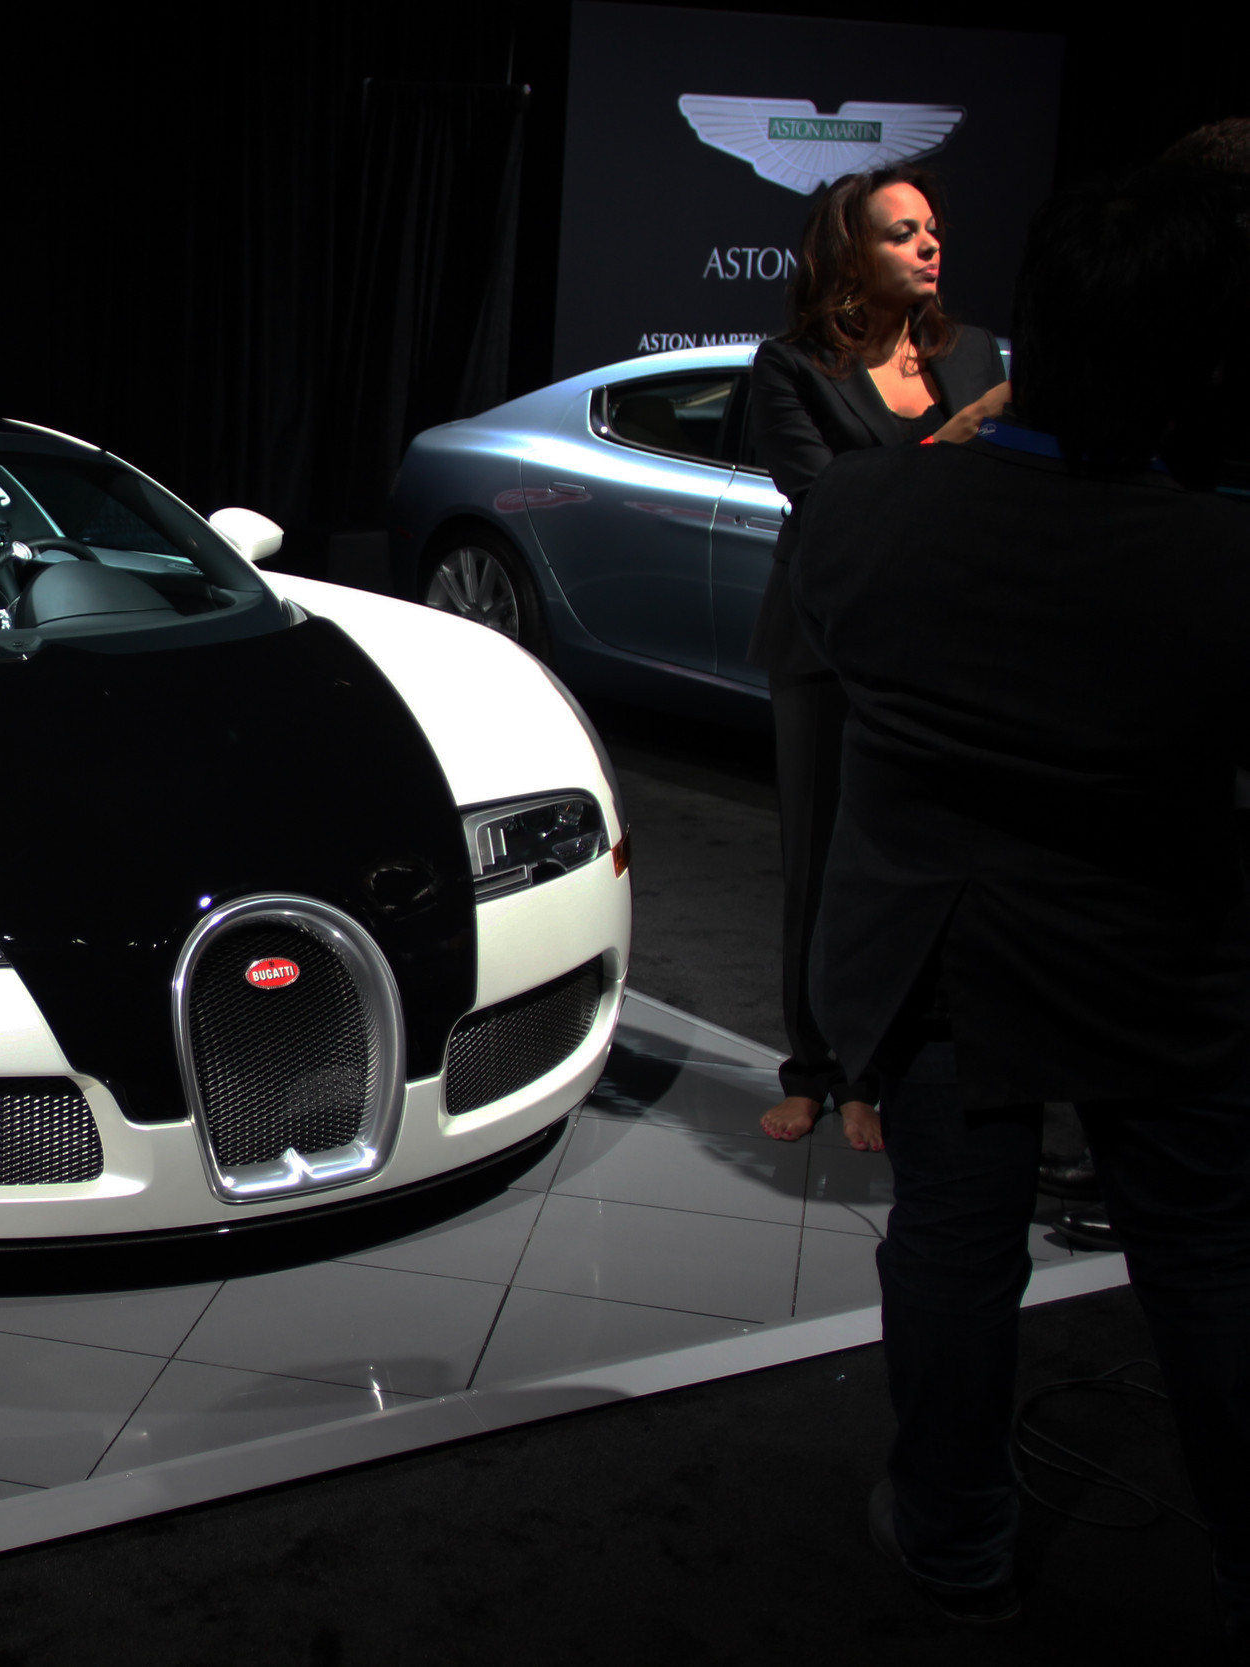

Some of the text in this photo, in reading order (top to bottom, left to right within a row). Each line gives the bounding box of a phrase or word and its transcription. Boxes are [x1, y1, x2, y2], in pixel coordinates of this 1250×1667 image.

[771, 120, 880, 139] ASTON MARTIN
[702, 246, 797, 280] ASTON
[638, 333, 697, 351] ASTON
[251, 965, 296, 983] BUGATTI
